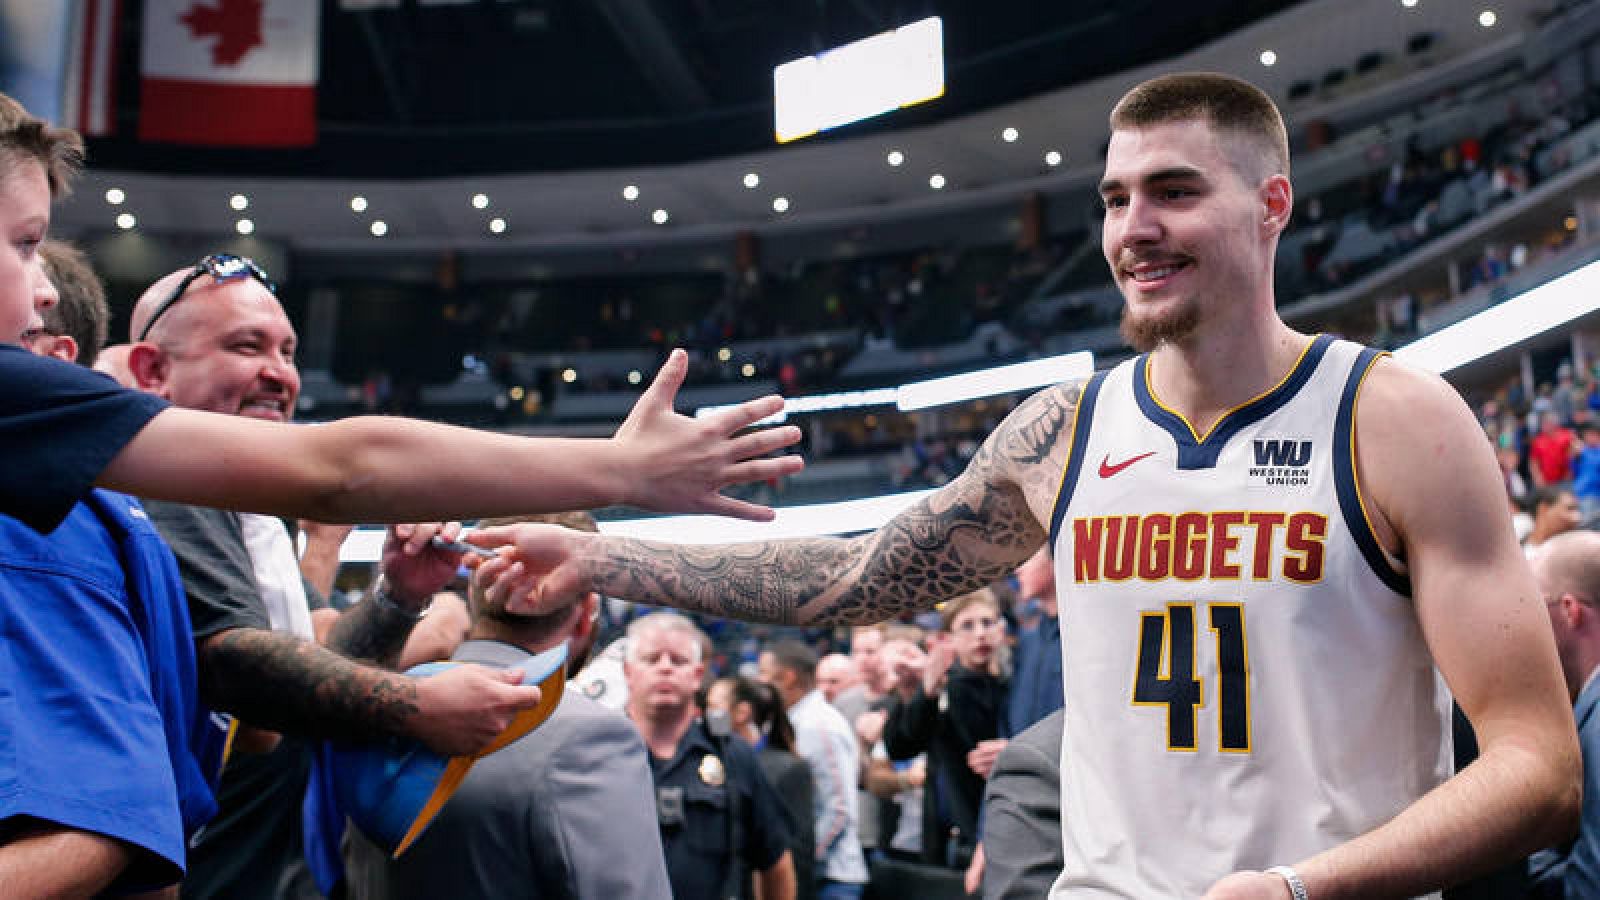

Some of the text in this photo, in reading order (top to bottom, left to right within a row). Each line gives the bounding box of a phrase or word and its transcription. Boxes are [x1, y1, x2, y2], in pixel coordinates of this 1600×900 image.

[1254, 440, 1312, 466] WU
[1249, 468, 1309, 476] WESTERN
[1266, 477, 1309, 485] UNION
[1073, 511, 1328, 584] NUGGETS
[1132, 602, 1252, 752] 41
